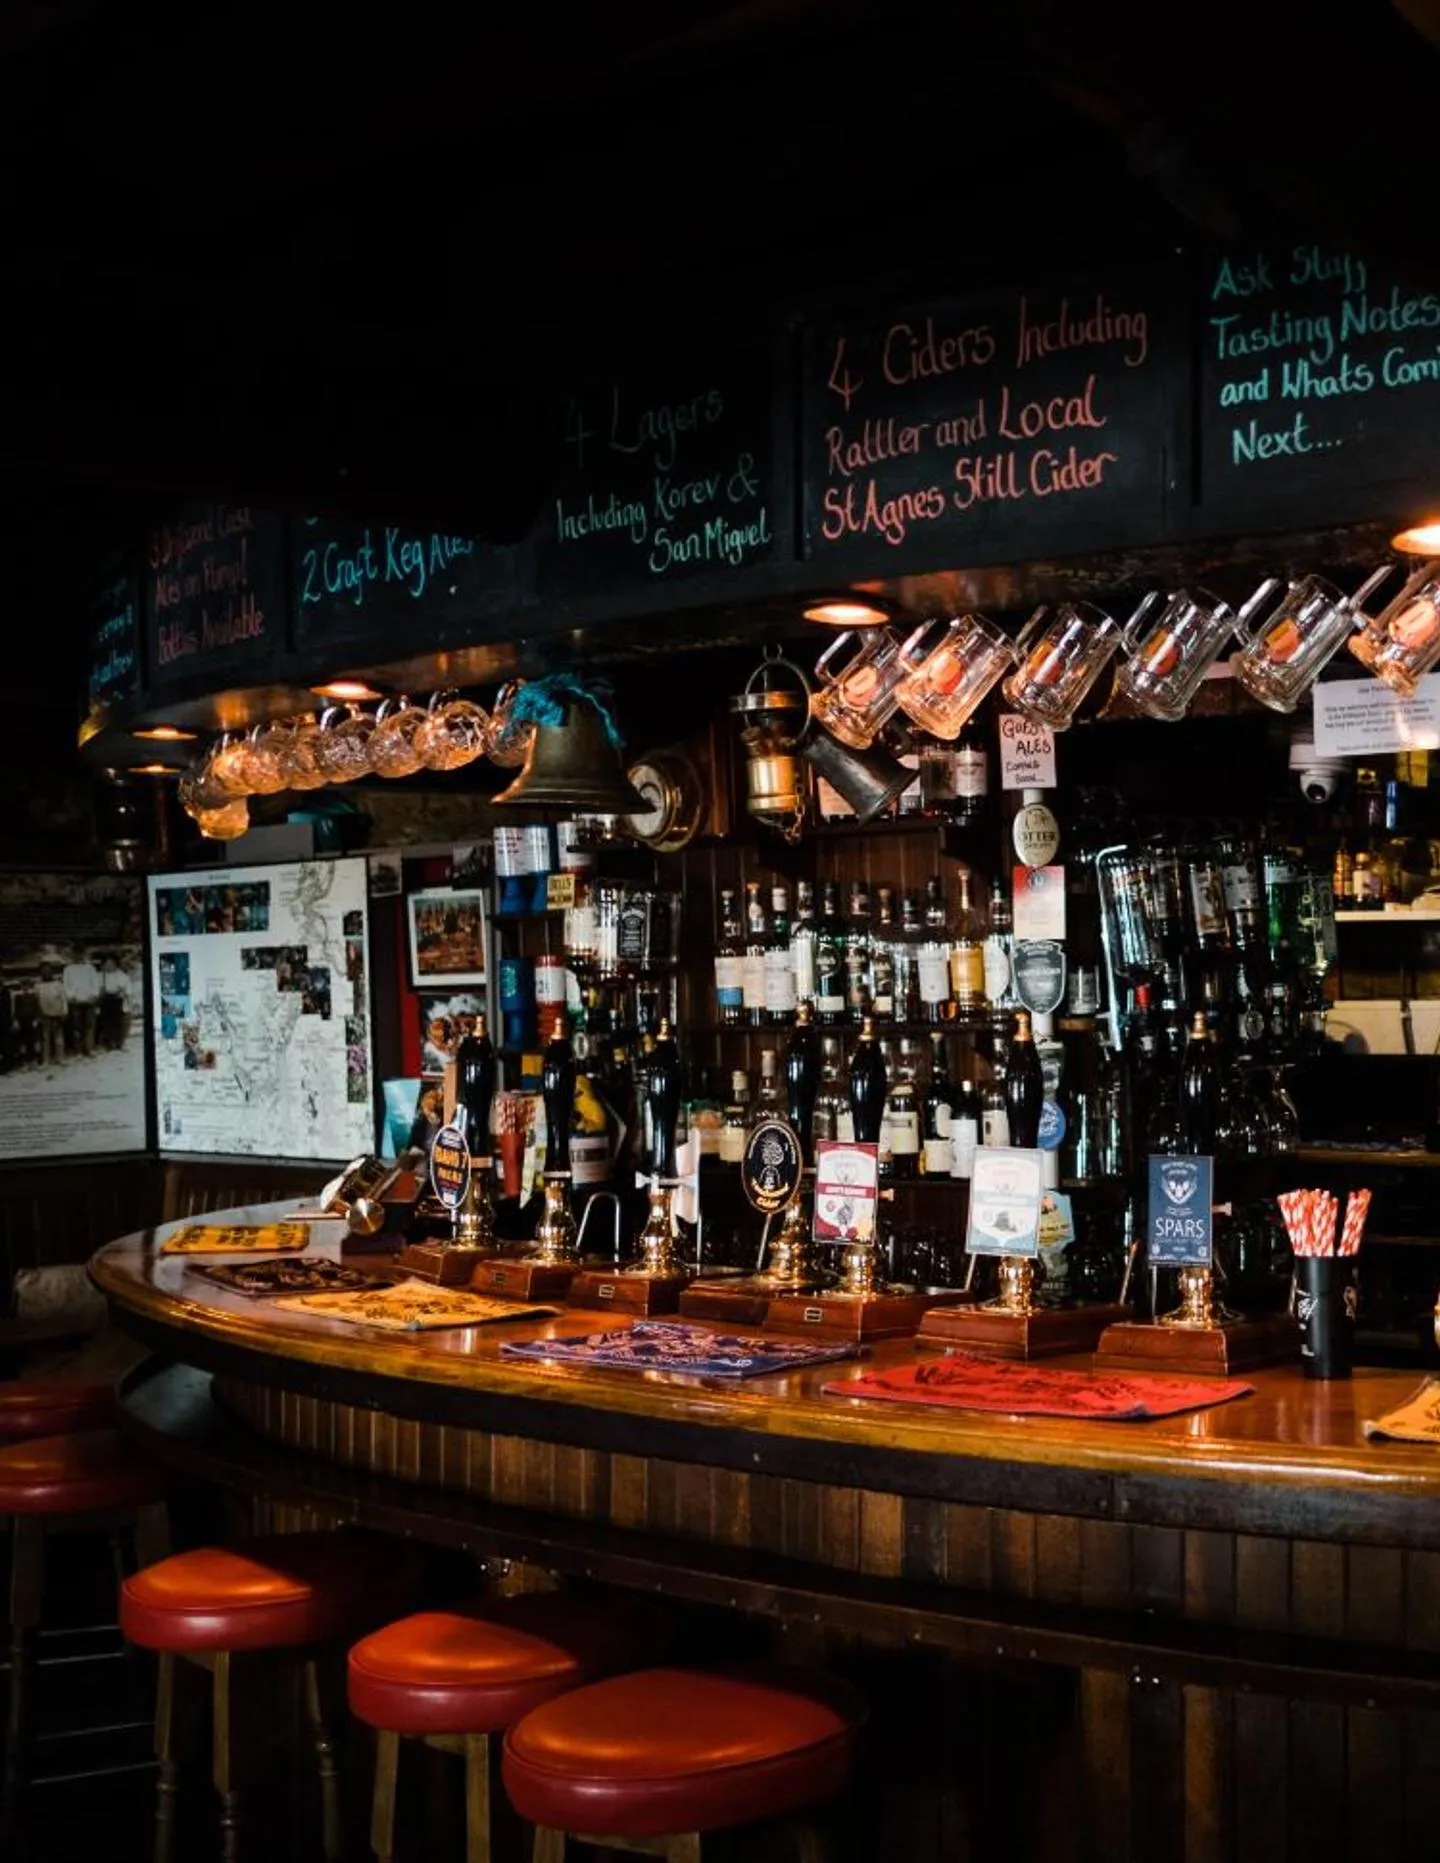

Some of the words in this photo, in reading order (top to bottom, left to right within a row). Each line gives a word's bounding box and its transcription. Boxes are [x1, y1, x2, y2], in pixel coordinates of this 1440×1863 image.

[1211, 250, 1275, 301] Ask
[1290, 244, 1369, 293] Staff
[825, 337, 865, 412] 4
[882, 317, 998, 390] Ciders
[1014, 294, 1151, 369] Including
[1210, 303, 1335, 363] Tasting
[1218, 362, 1270, 409] and
[1280, 354, 1376, 400] Whats
[607, 381, 726, 473] Lagers
[824, 413, 933, 477] Rattler
[934, 407, 988, 451] and
[997, 373, 1107, 442] Local
[555, 490, 649, 545] Including
[652, 471, 723, 523] Korev
[725, 451, 761, 505] &
[861, 478, 946, 547] Agnes
[953, 447, 1024, 511] Still
[1028, 448, 1120, 497] Cider
[300, 547, 322, 605] 2
[322, 526, 379, 607] Craft
[383, 524, 427, 599] Keg
[647, 525, 702, 575] San
[704, 505, 773, 567] Miguel
[1015, 738, 1052, 757] ALES
[1154, 1216, 1206, 1239] SPARS
